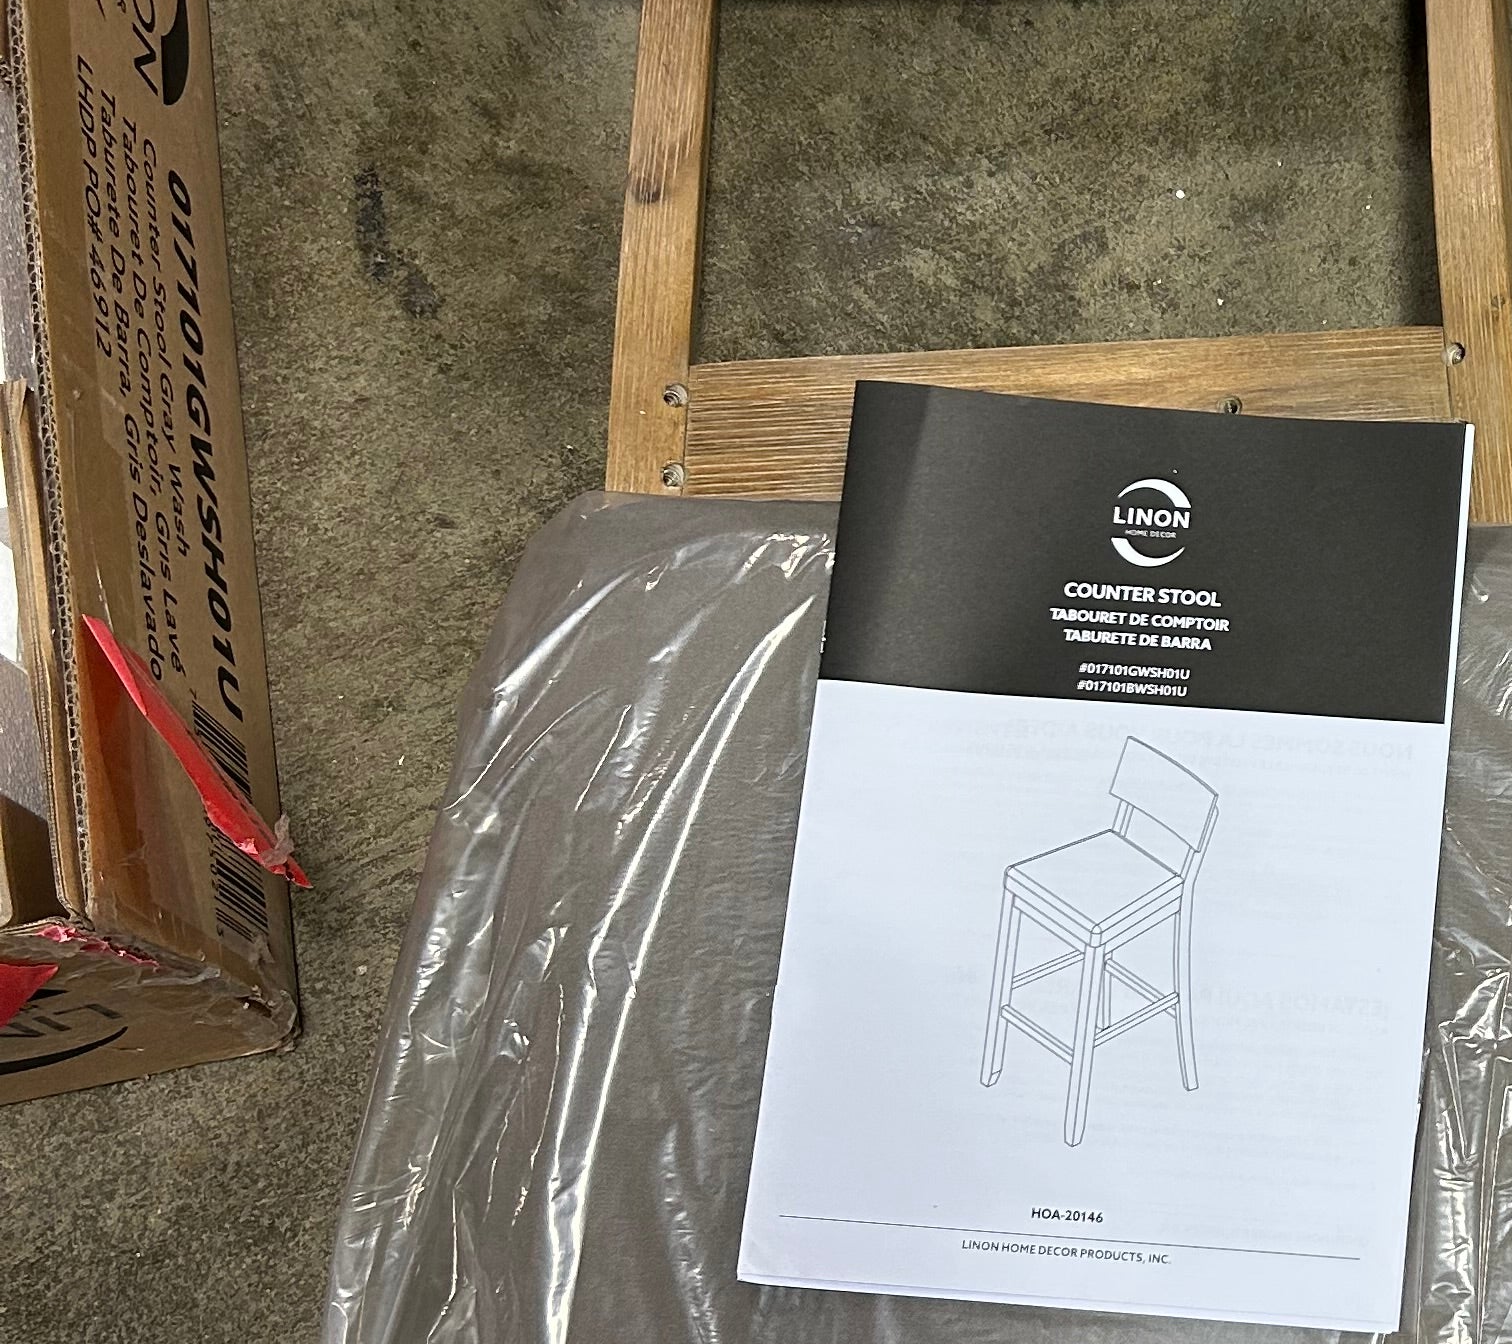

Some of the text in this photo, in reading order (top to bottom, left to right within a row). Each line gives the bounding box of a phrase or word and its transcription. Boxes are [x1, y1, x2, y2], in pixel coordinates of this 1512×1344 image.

[77, 54, 112, 358] LHDP PO# 46912
[143, 138, 190, 557] Counter Stool Gray Wash
[101, 89, 164, 681] Taburete De Barra, Gris Deslavado
[122, 116, 186, 677] Tabouret De Comptoir, Gris Lavé
[168, 169, 243, 723] 017101GWSH01U
[1112, 506, 1191, 529] LINON
[1124, 529, 1177, 539] HOME DECOR
[1063, 582, 1222, 607] COUNTER STOOL
[1049, 607, 1230, 632] TABOURET DE COMPTOIR
[1063, 628, 1212, 650] TABURETE DE BARRA
[1078, 663, 1191, 680] #017101GWSH01U
[1077, 680, 1188, 697] #017101BWSH01U
[1031, 1207, 1104, 1223] HOA-20146
[962, 1240, 999, 1252] LINON
[1001, 1242, 1036, 1255] HOME
[1038, 1245, 1078, 1258] DECOR
[1080, 1249, 1146, 1264] PRODUCTS,
